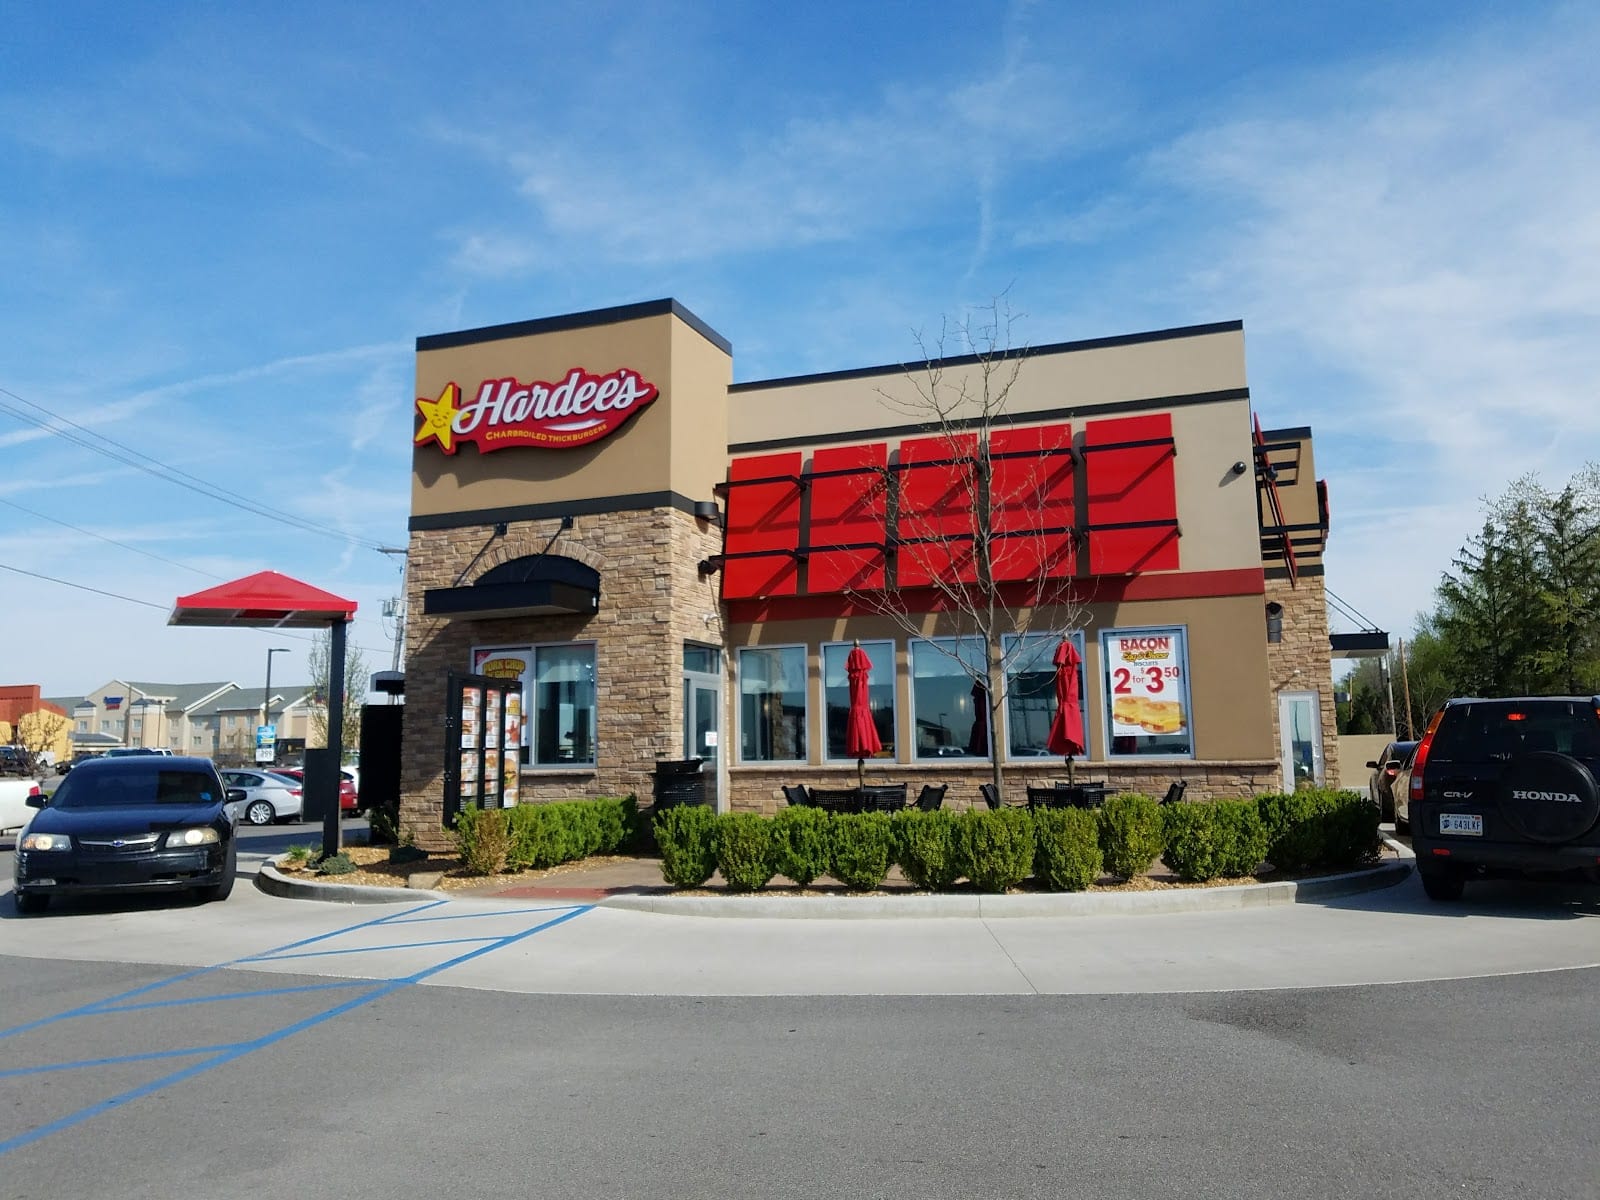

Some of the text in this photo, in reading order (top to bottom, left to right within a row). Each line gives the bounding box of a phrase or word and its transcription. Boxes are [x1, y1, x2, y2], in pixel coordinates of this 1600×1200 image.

[452, 371, 650, 434] Hardee's
[485, 430, 547, 441] CHARBROILED
[1120, 637, 1169, 650] BACON
[1114, 668, 1131, 694] 2
[1132, 676, 1144, 684] for
[1443, 790, 1582, 803] CR-V HONDA
